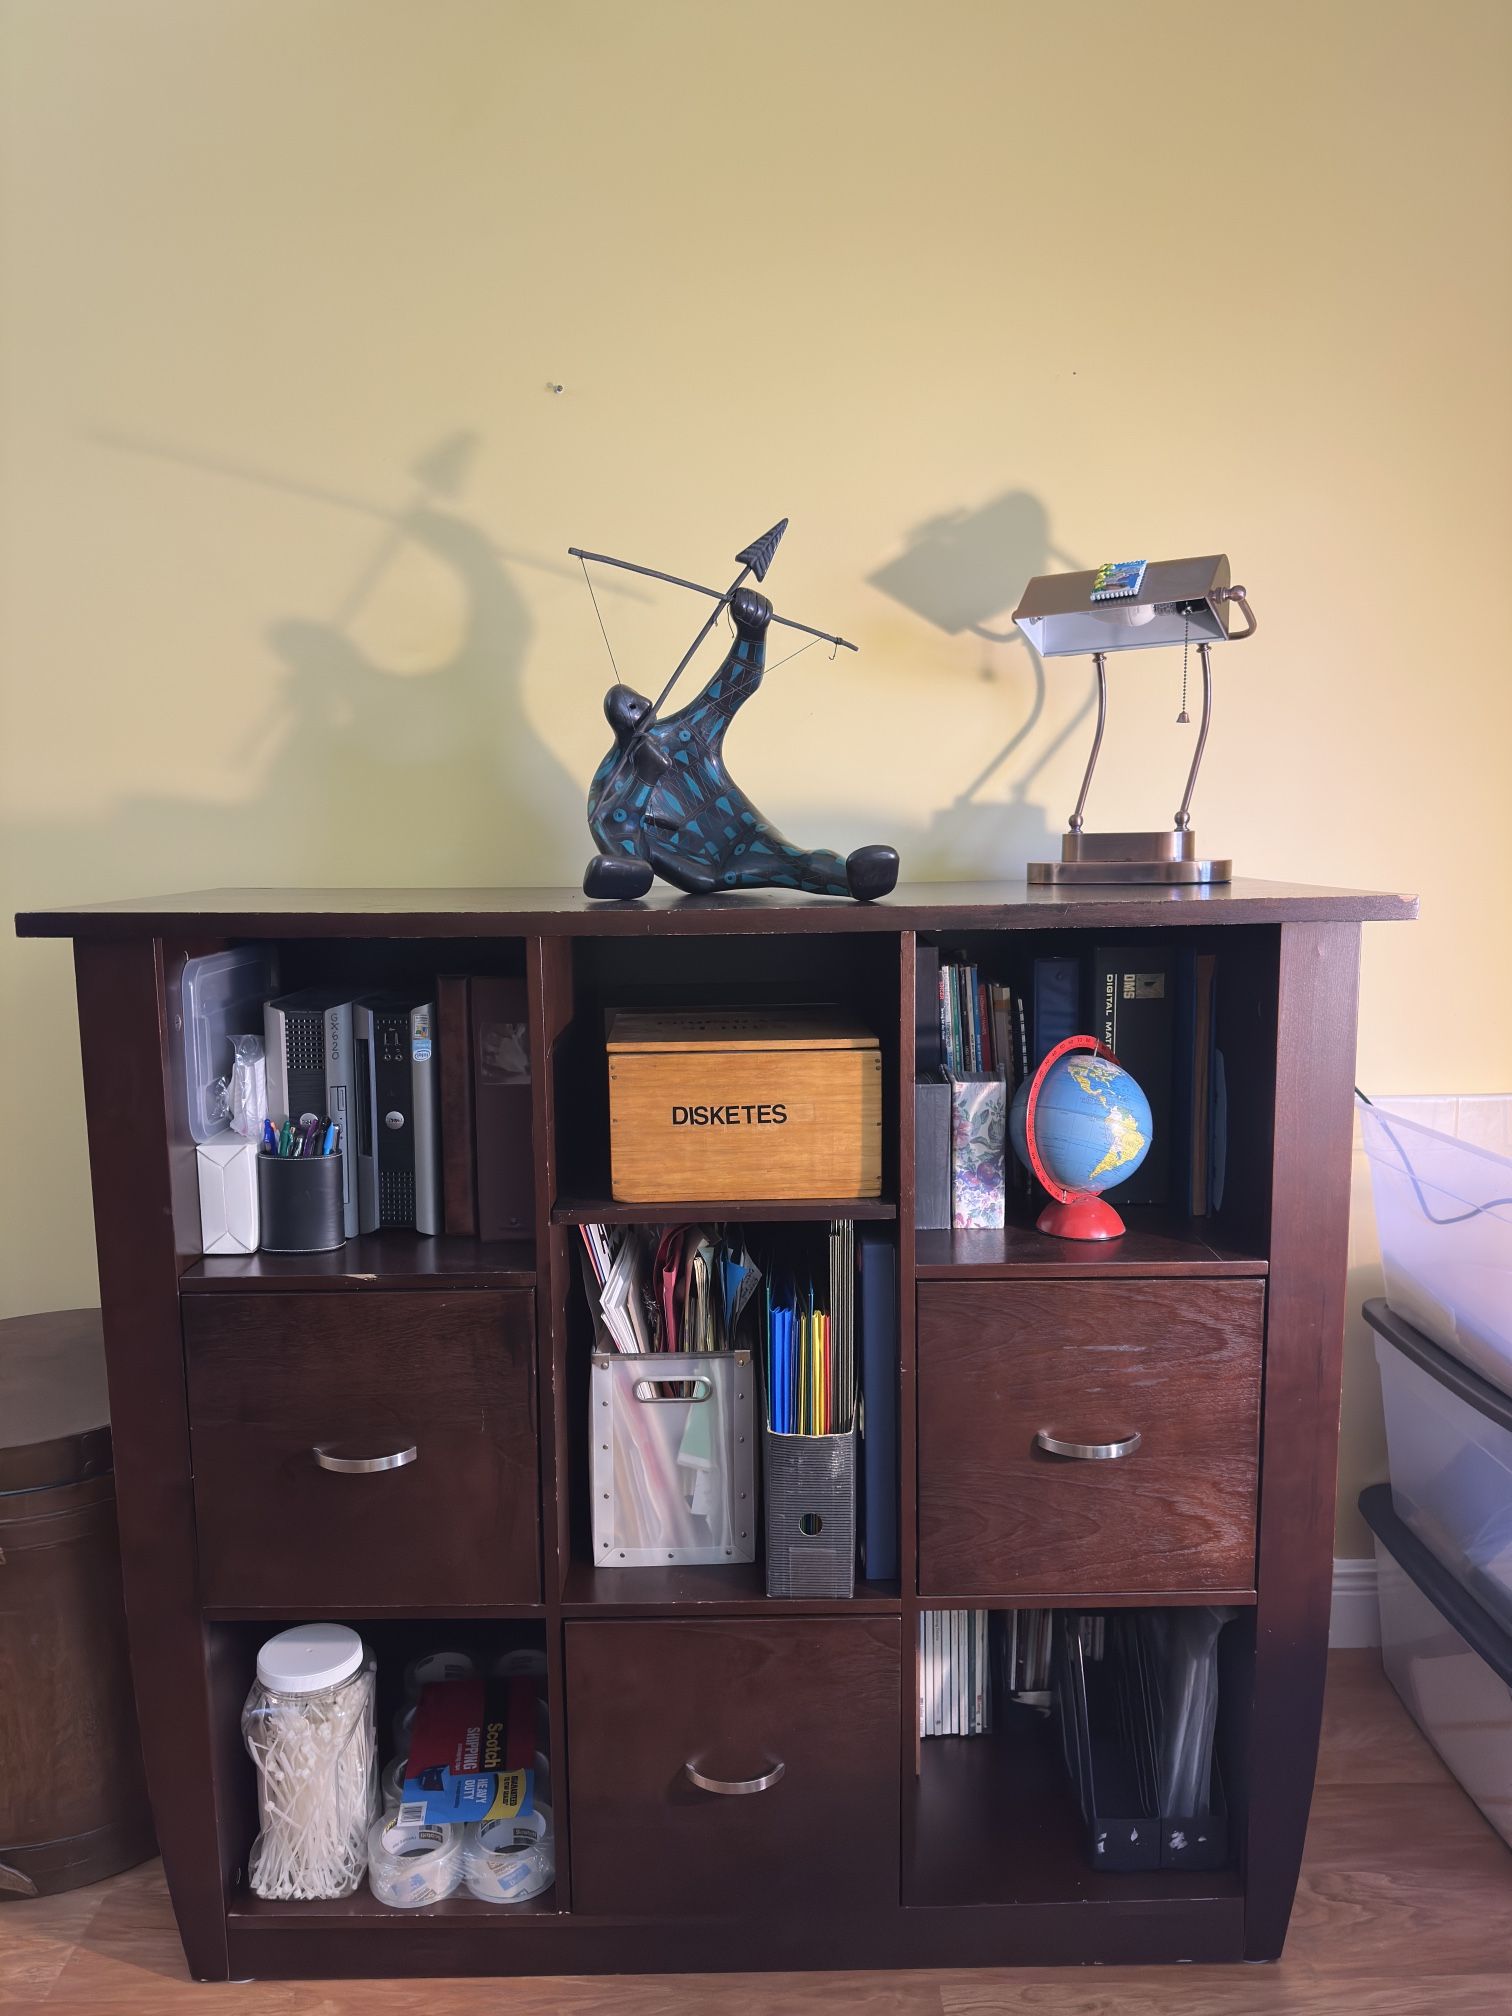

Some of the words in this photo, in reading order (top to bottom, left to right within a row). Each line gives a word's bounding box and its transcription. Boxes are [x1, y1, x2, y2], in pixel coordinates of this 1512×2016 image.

[1105, 974, 1113, 1016] DIGITAL
[1123, 974, 1136, 999] DMS
[330, 1013, 340, 1060] GX620
[672, 1104, 787, 1126] DISKETES
[462, 1727, 480, 1770] SHIPPING
[484, 1723, 504, 1768] Scotch
[463, 1779, 475, 1800] DUTY
[475, 1778, 489, 1804] HEAVY
